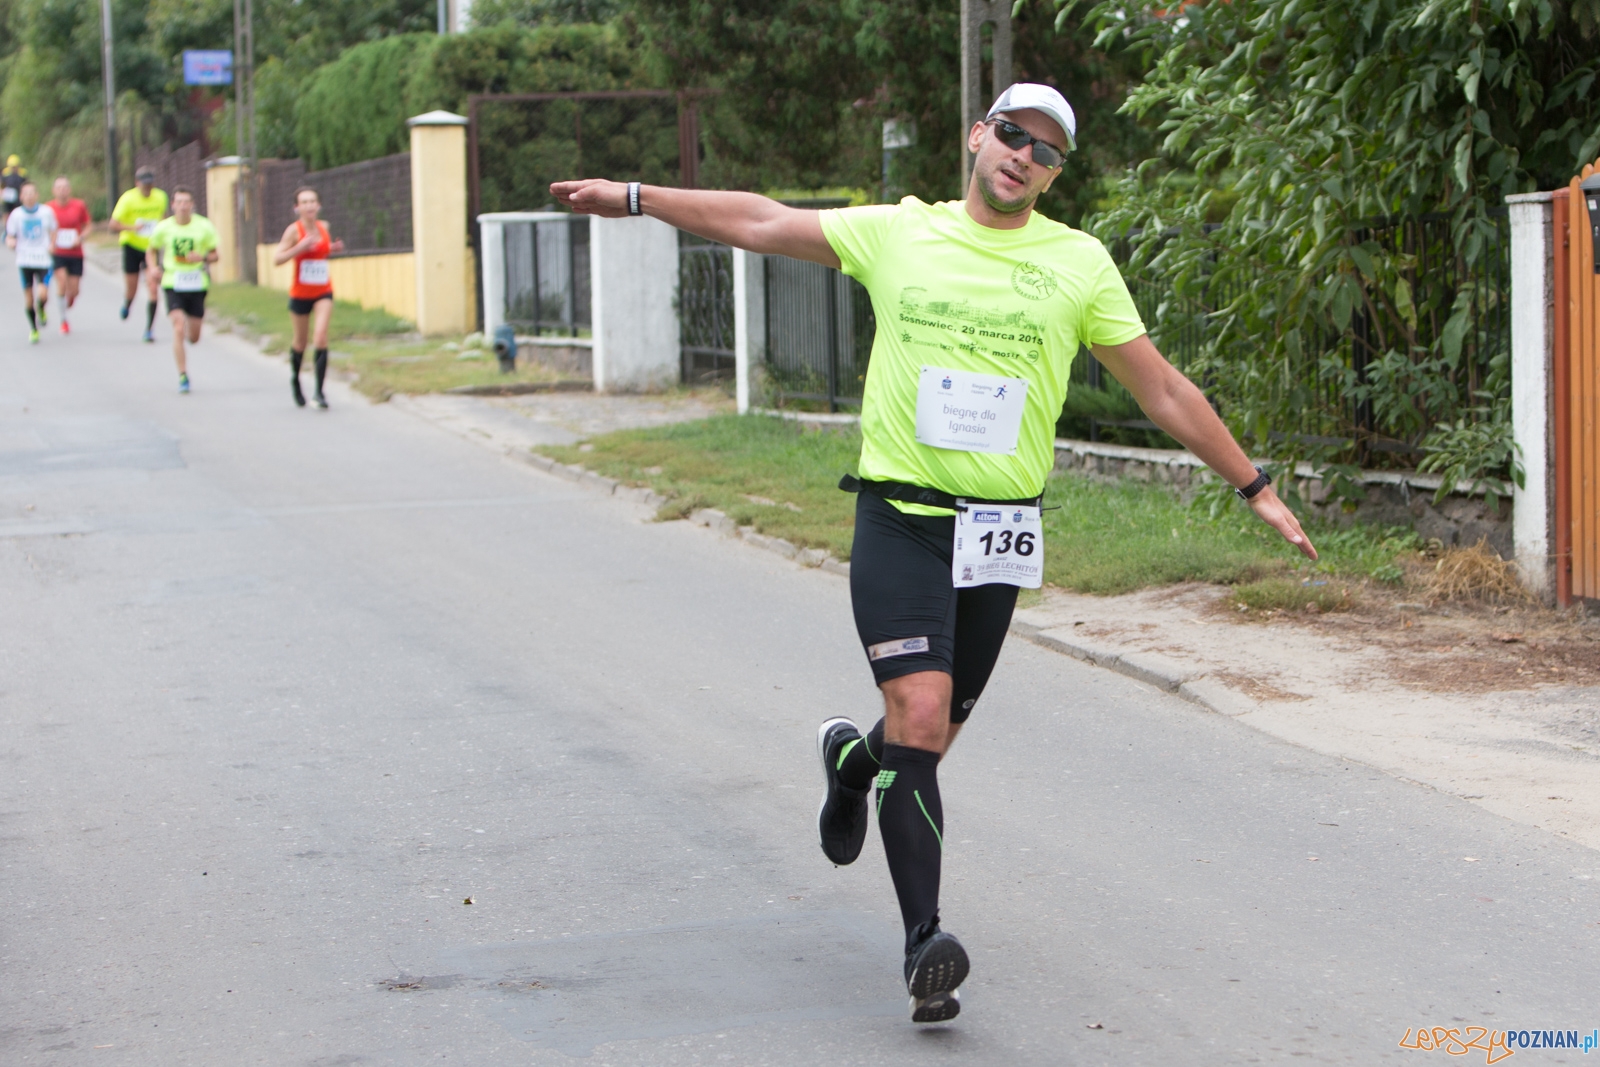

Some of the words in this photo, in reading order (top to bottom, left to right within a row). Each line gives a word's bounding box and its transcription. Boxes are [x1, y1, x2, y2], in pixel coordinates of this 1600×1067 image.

[899, 313, 957, 332] Sosnowiec,
[962, 325, 975, 335] 29
[979, 330, 1015, 341] marca
[1018, 333, 1044, 345] 2015
[942, 403, 978, 421] biegnę
[980, 410, 996, 421] dla
[948, 420, 987, 435] Ignasia
[979, 530, 1036, 556] 136
